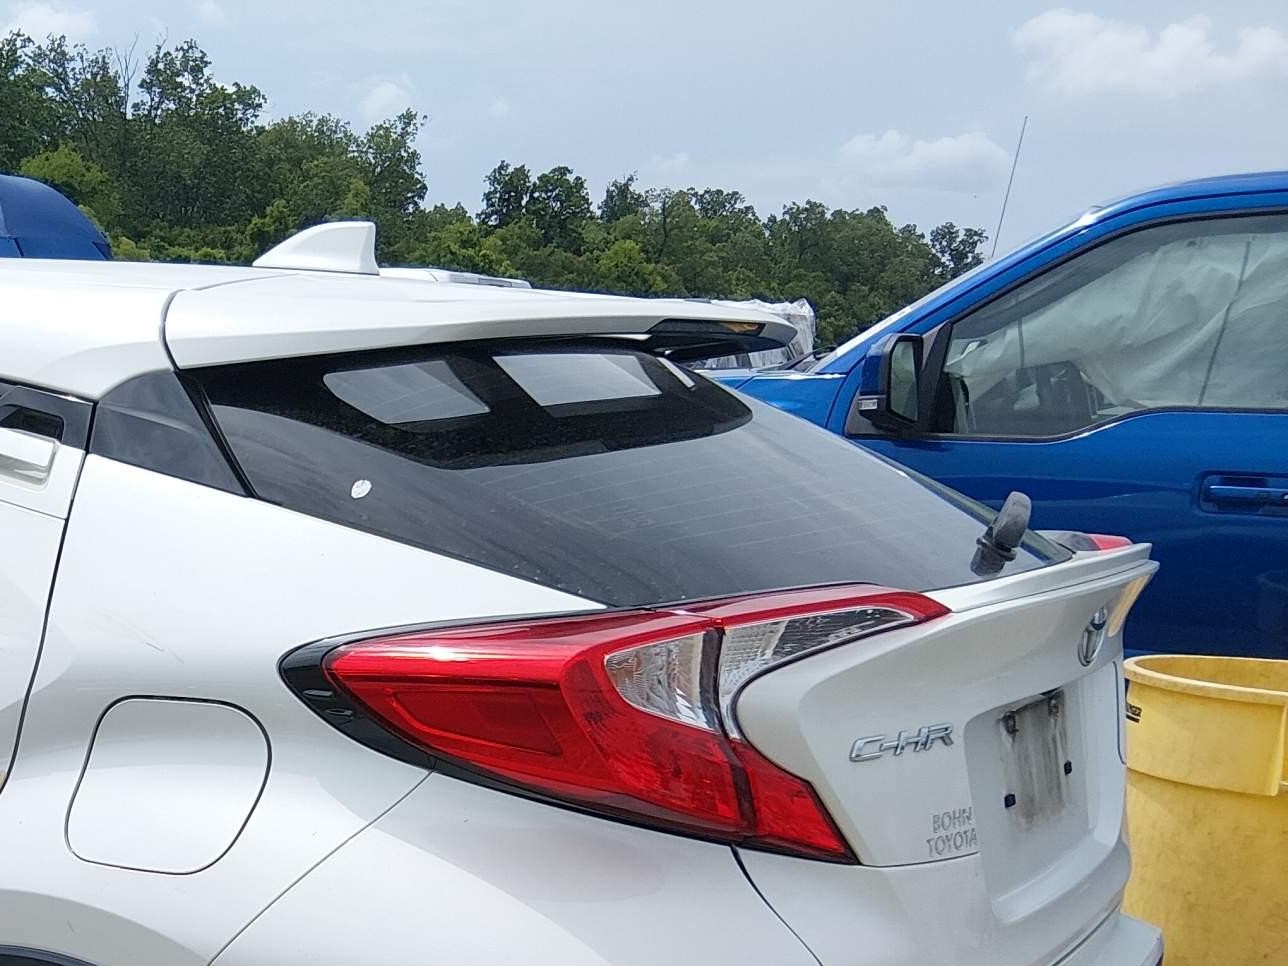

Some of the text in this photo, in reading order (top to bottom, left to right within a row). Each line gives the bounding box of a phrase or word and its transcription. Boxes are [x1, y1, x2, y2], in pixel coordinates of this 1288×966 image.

[849, 722, 954, 762] C-HR
[932, 805, 972, 834] BOHN
[925, 827, 978, 858] TOYOTA
